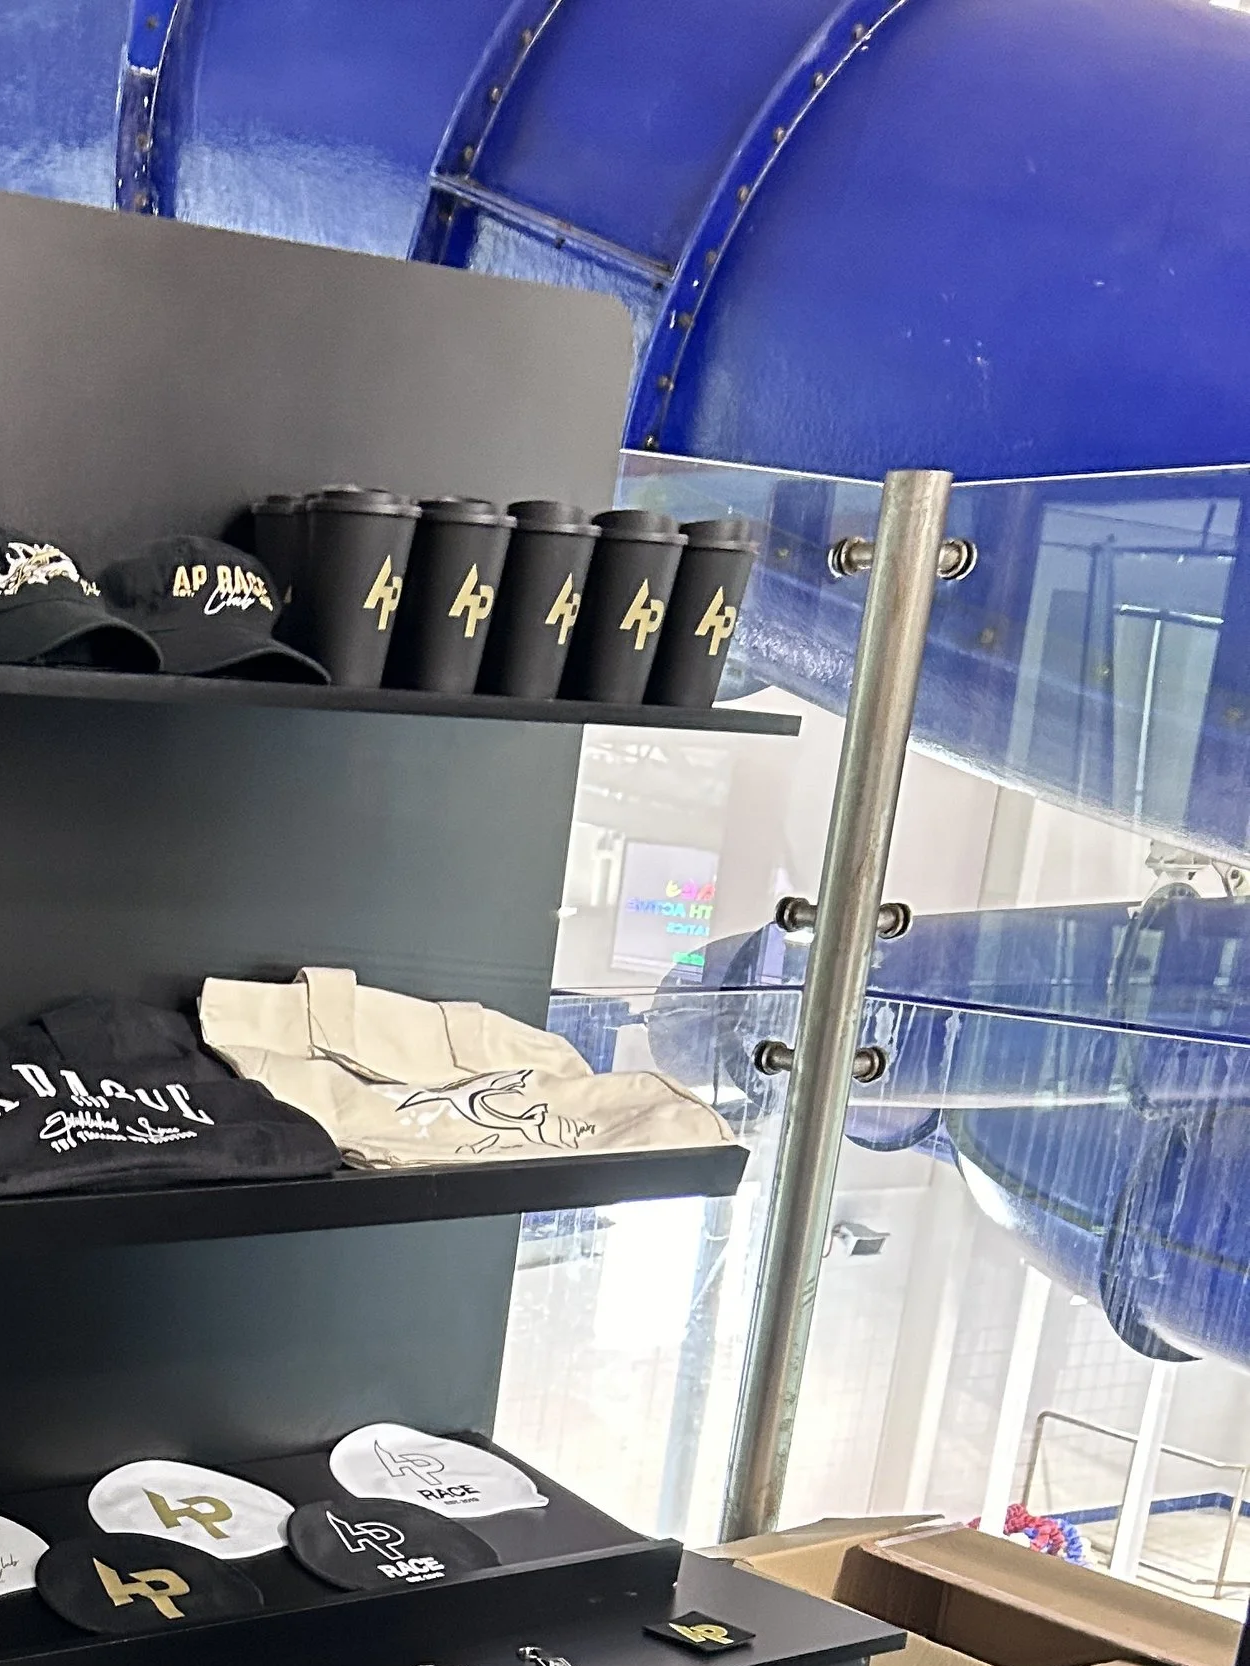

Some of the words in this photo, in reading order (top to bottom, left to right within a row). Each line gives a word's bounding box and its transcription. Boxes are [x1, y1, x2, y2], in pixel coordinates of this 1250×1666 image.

[173, 564, 208, 592] AP
[363, 554, 403, 631] AP
[448, 563, 495, 638] AP
[544, 572, 581, 645] AP
[619, 578, 665, 650] AP
[695, 586, 736, 656] AP
[374, 1440, 445, 1486] AP
[142, 1487, 233, 1539] AP
[416, 1485, 481, 1501] RACE
[326, 1510, 405, 1560] AP
[93, 1557, 191, 1619] AP
[377, 1557, 445, 1579] RACE
